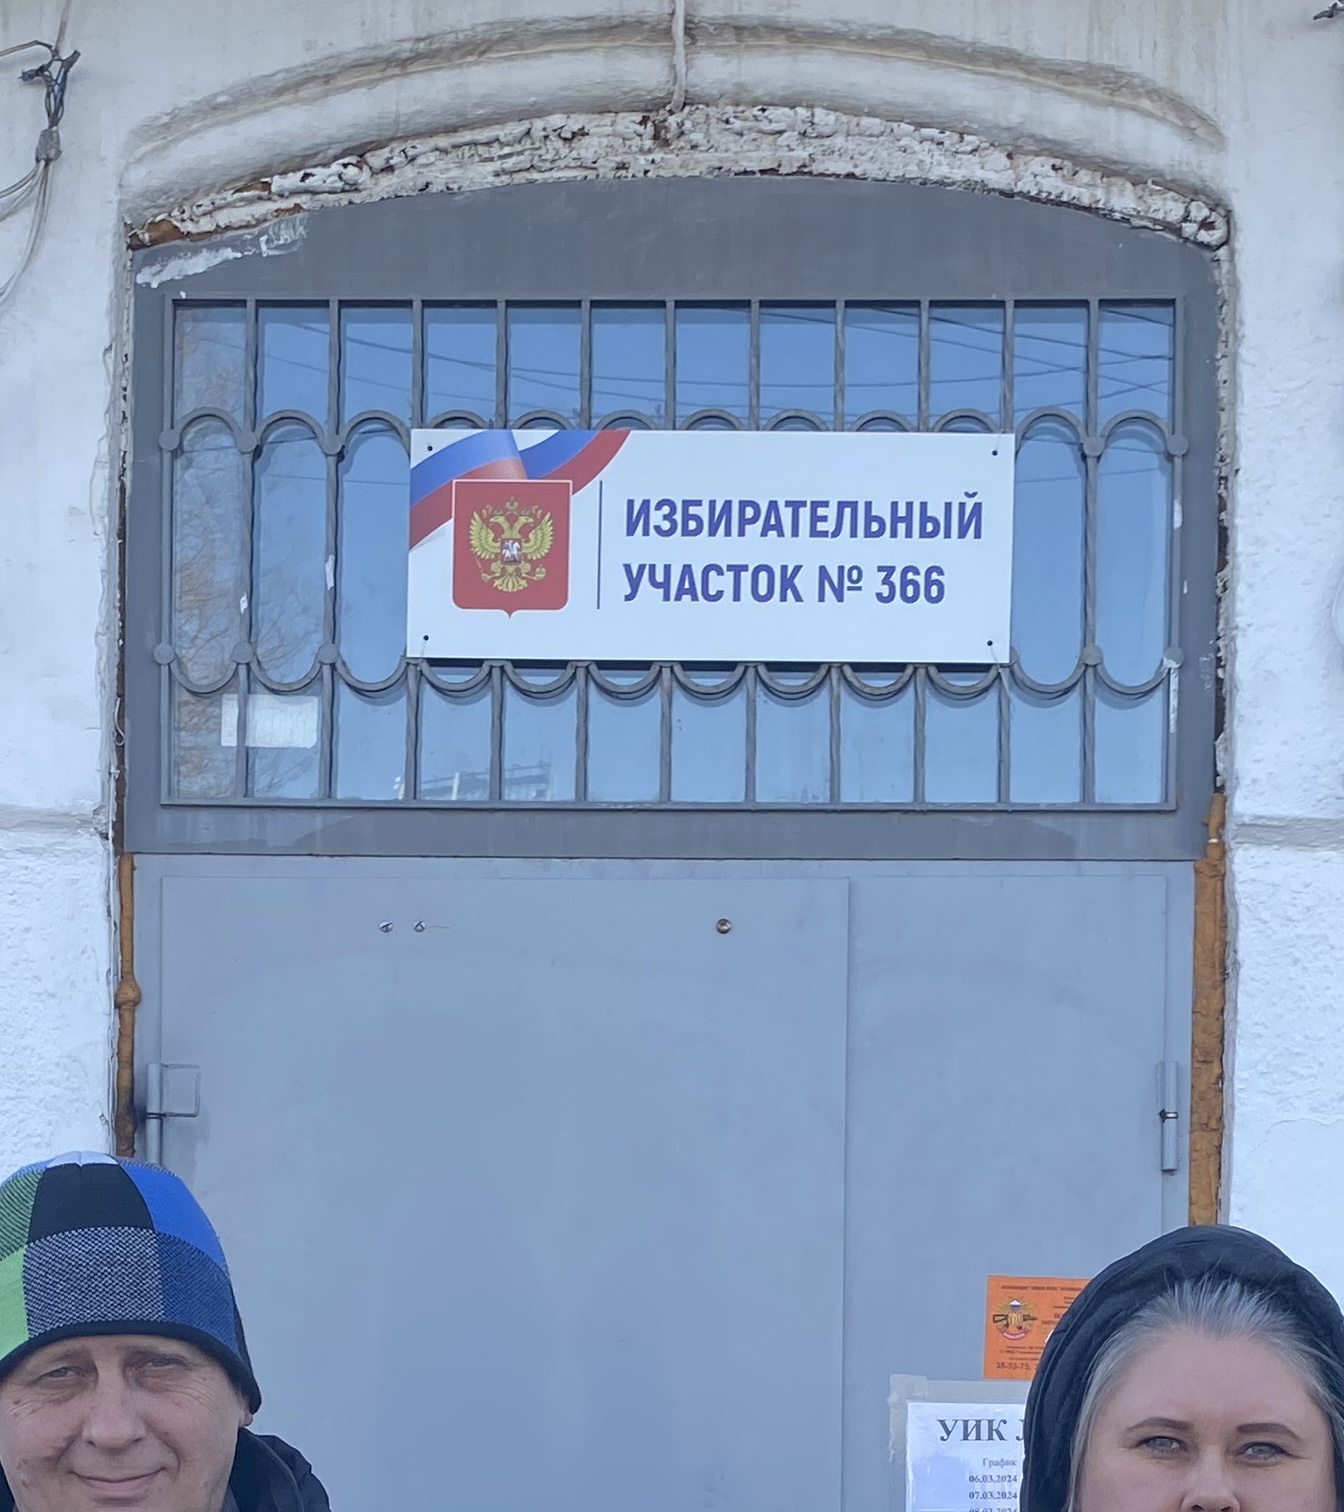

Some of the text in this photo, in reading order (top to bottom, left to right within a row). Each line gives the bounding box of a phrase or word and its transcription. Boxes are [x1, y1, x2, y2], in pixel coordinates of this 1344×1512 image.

[625, 491, 983, 540] ИЗБИРАТЕЛЬНЫЙ
[623, 563, 946, 604] УЧАСТОК № 366
[936, 1418, 1008, 1442] УИК
[982, 1458, 1017, 1468] График
[969, 1474, 1018, 1484] 06.03.2024
[969, 1491, 1018, 1500] 07.03.2024
